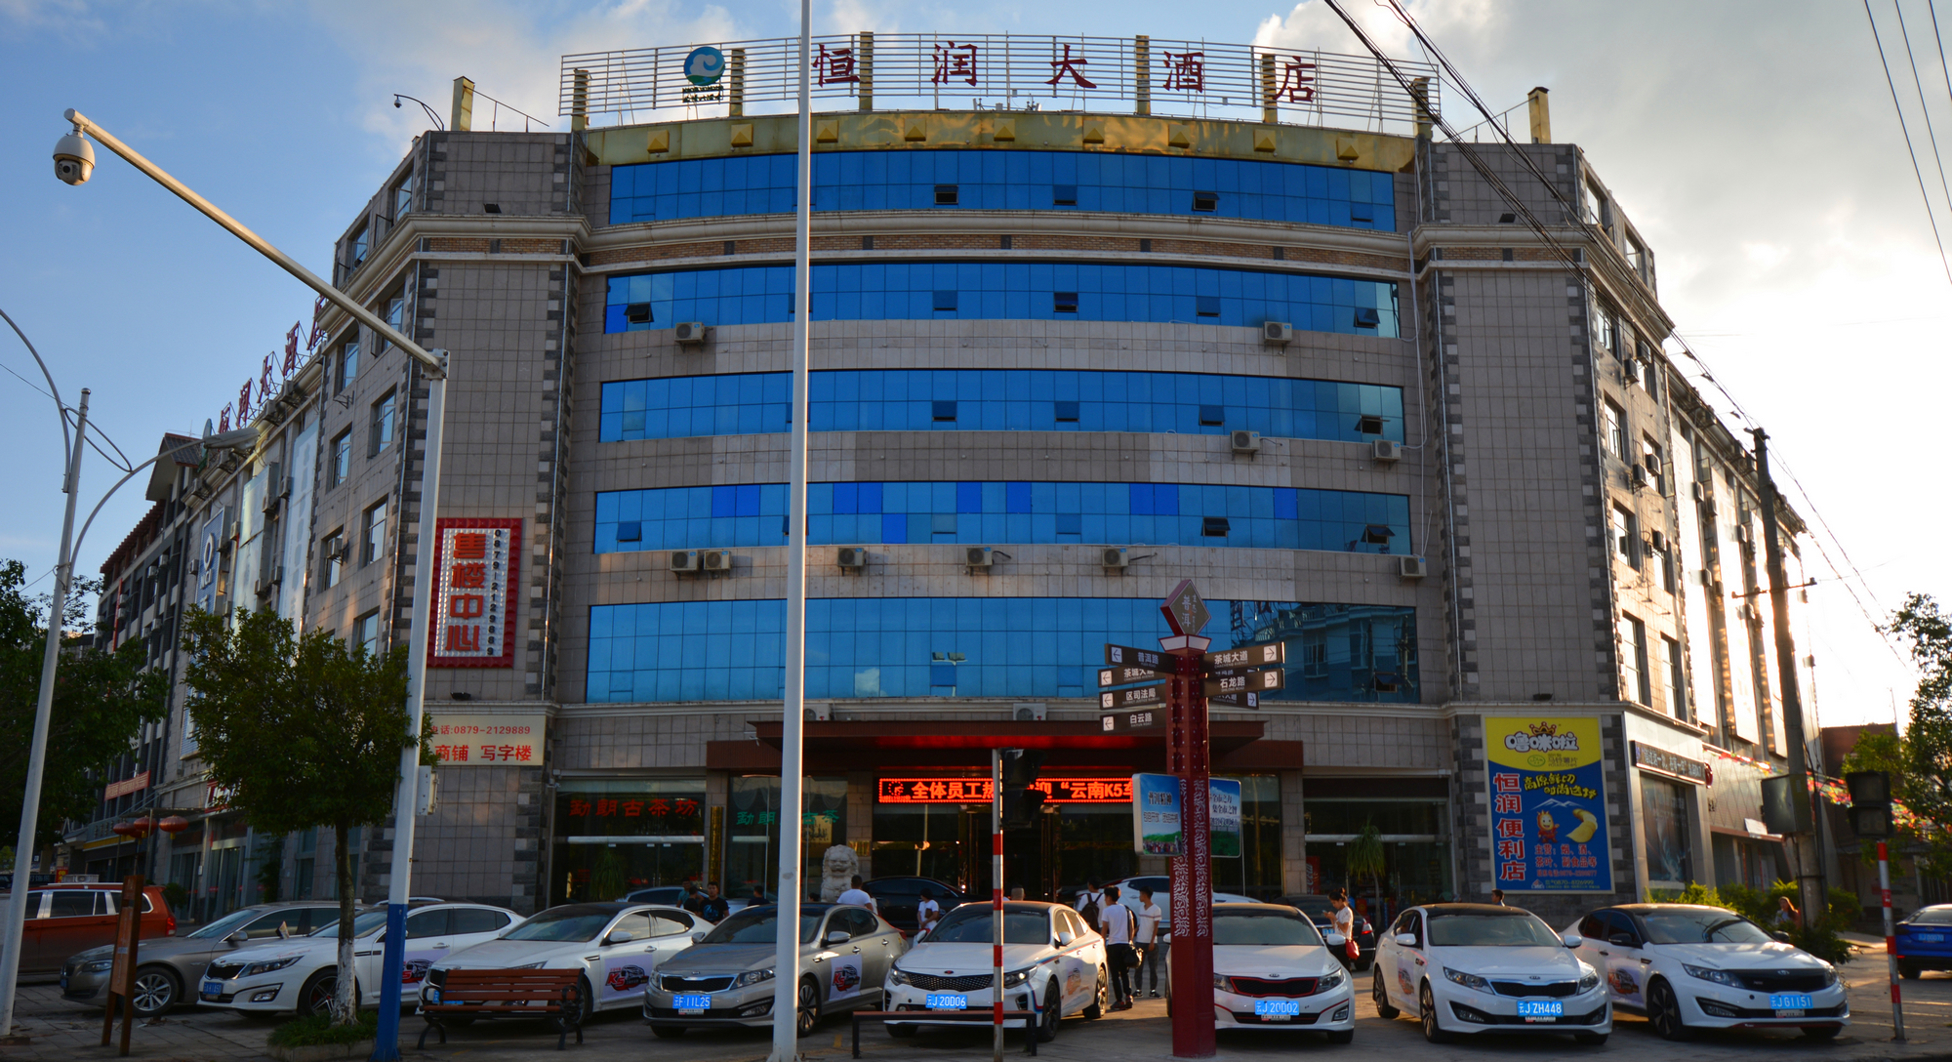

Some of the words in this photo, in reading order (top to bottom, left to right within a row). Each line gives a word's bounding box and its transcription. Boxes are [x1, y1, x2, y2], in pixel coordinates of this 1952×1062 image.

[812, 41, 1316, 103] 恒润大酒店
[445, 533, 487, 651] 售楼中心
[1214, 650, 1248, 665] 茶城大道
[1220, 676, 1245, 689] 石龙路
[1126, 687, 1156, 701] 区司法局
[1130, 712, 1152, 724] 白云路
[434, 744, 469, 762] 商铺
[480, 744, 532, 762] 写字楼
[569, 798, 699, 817] 勐朗古茶坊
[736, 809, 840, 826] 勐朗古茶
[1493, 772, 1526, 882] 恒润便利店
